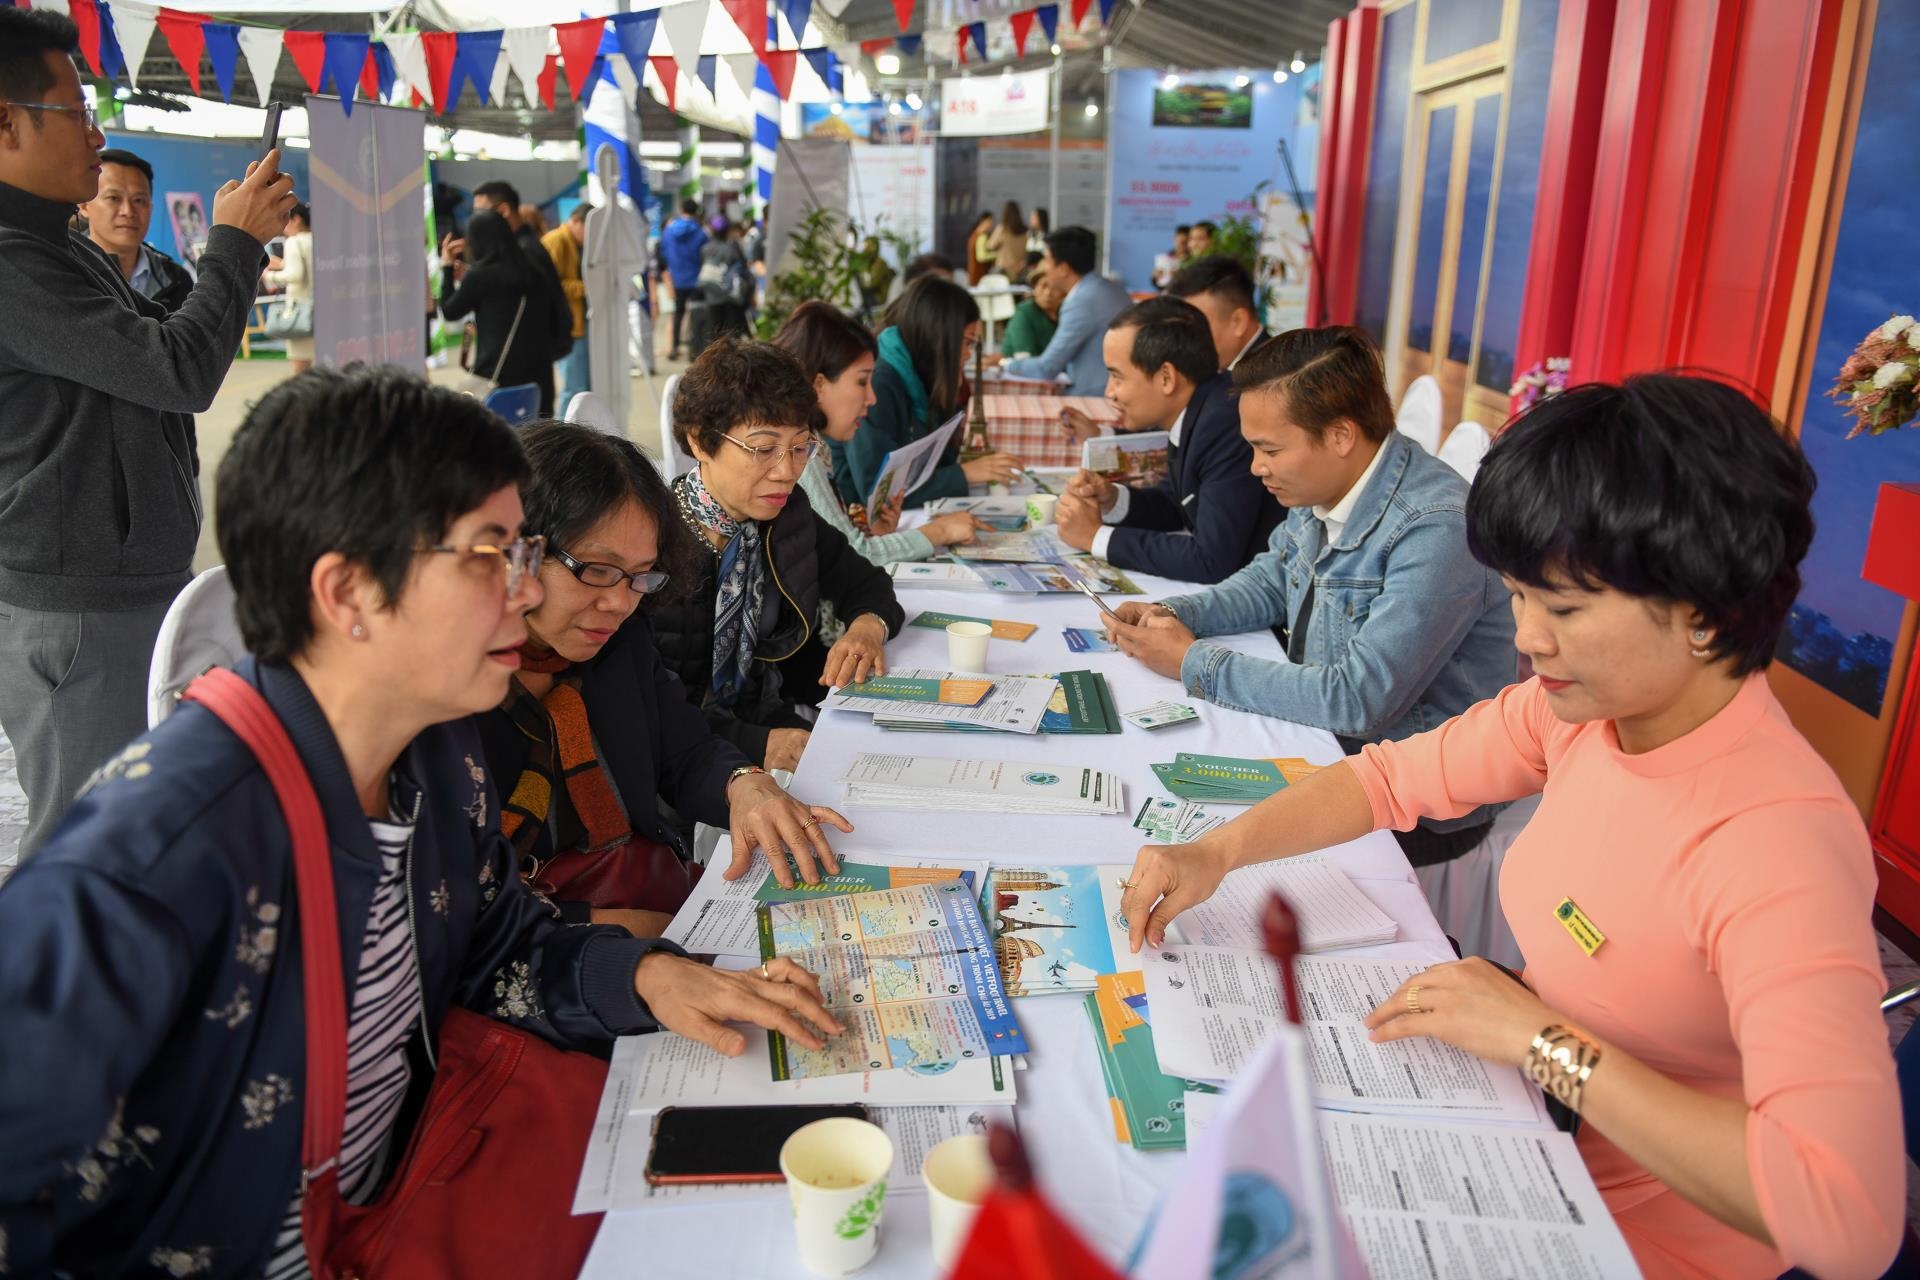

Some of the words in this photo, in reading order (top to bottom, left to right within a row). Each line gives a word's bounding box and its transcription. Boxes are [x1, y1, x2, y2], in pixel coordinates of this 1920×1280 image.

[1196, 763, 1260, 774] VOUCHER
[1184, 768, 1271, 782] 3.000.000
[770, 882, 872, 892] 3000.000
